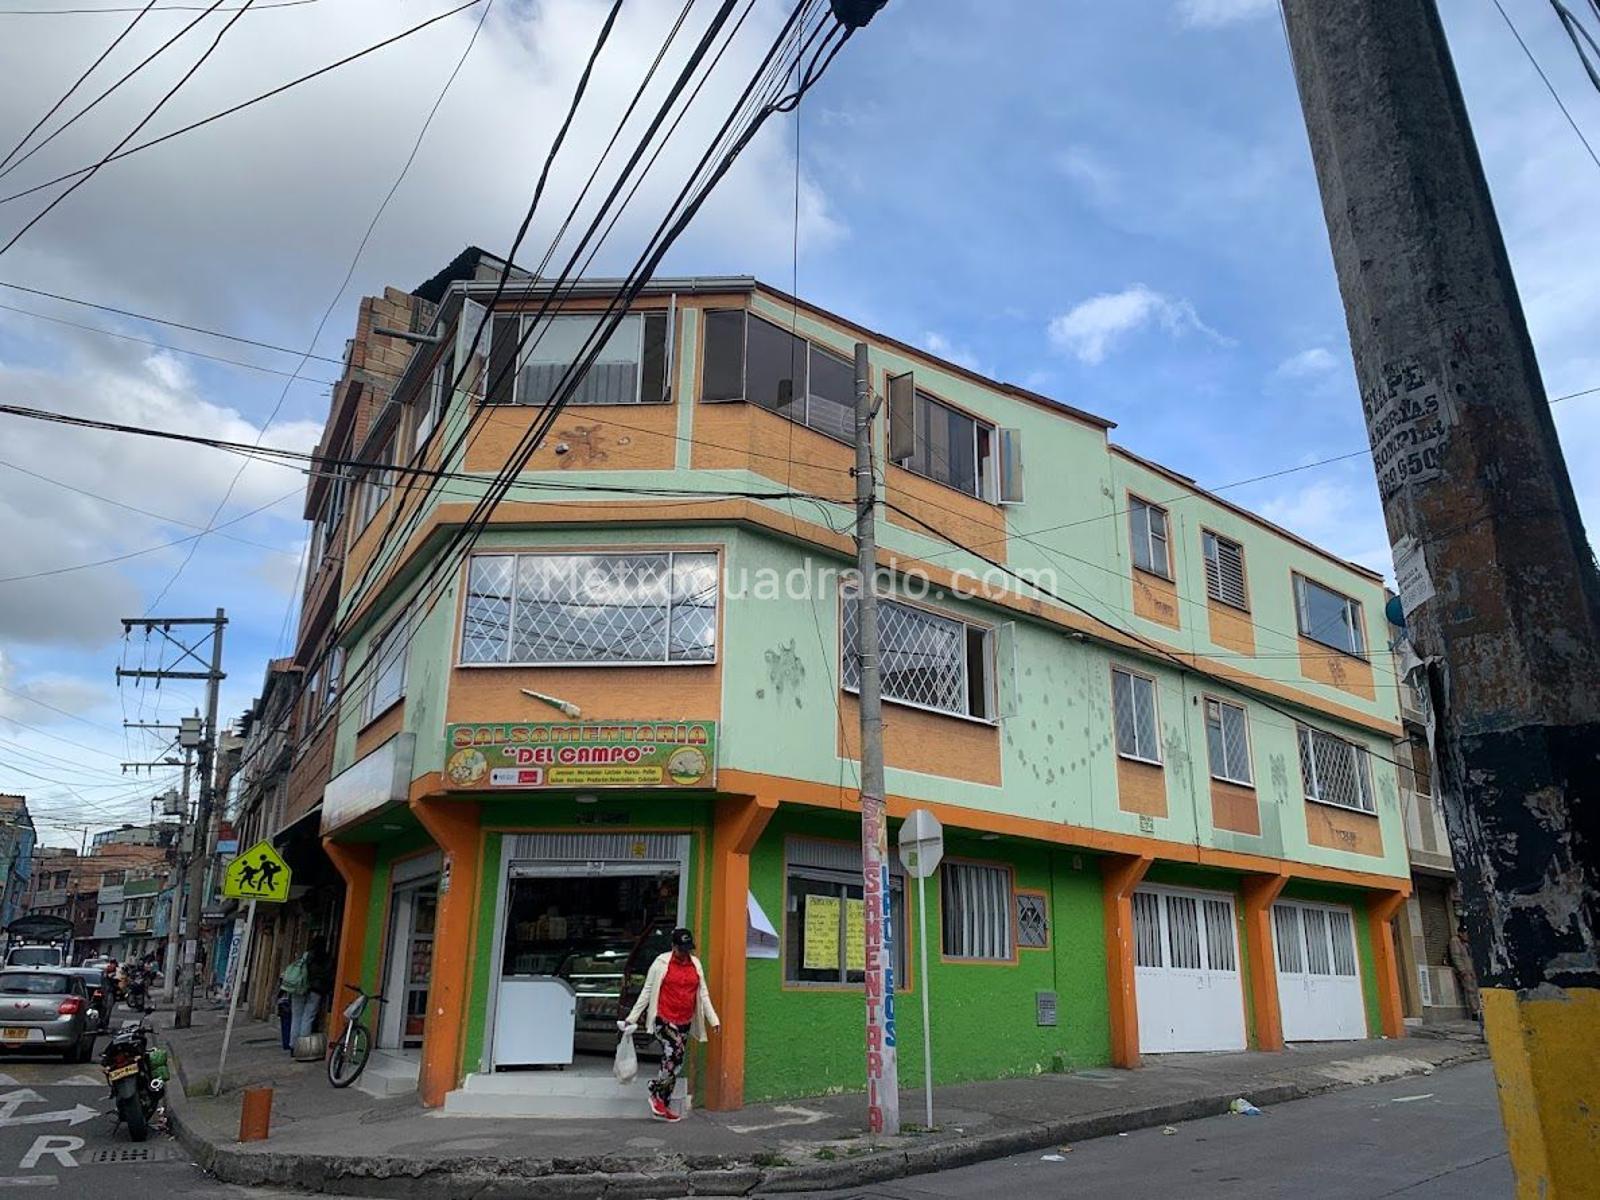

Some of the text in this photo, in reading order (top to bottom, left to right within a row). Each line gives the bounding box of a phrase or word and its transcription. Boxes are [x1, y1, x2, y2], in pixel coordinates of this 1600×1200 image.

[453, 725, 706, 747] SALSAMENTARIA
[863, 797, 884, 1133] SALSAMENTARIA
[18, 1134, 86, 1169] R
